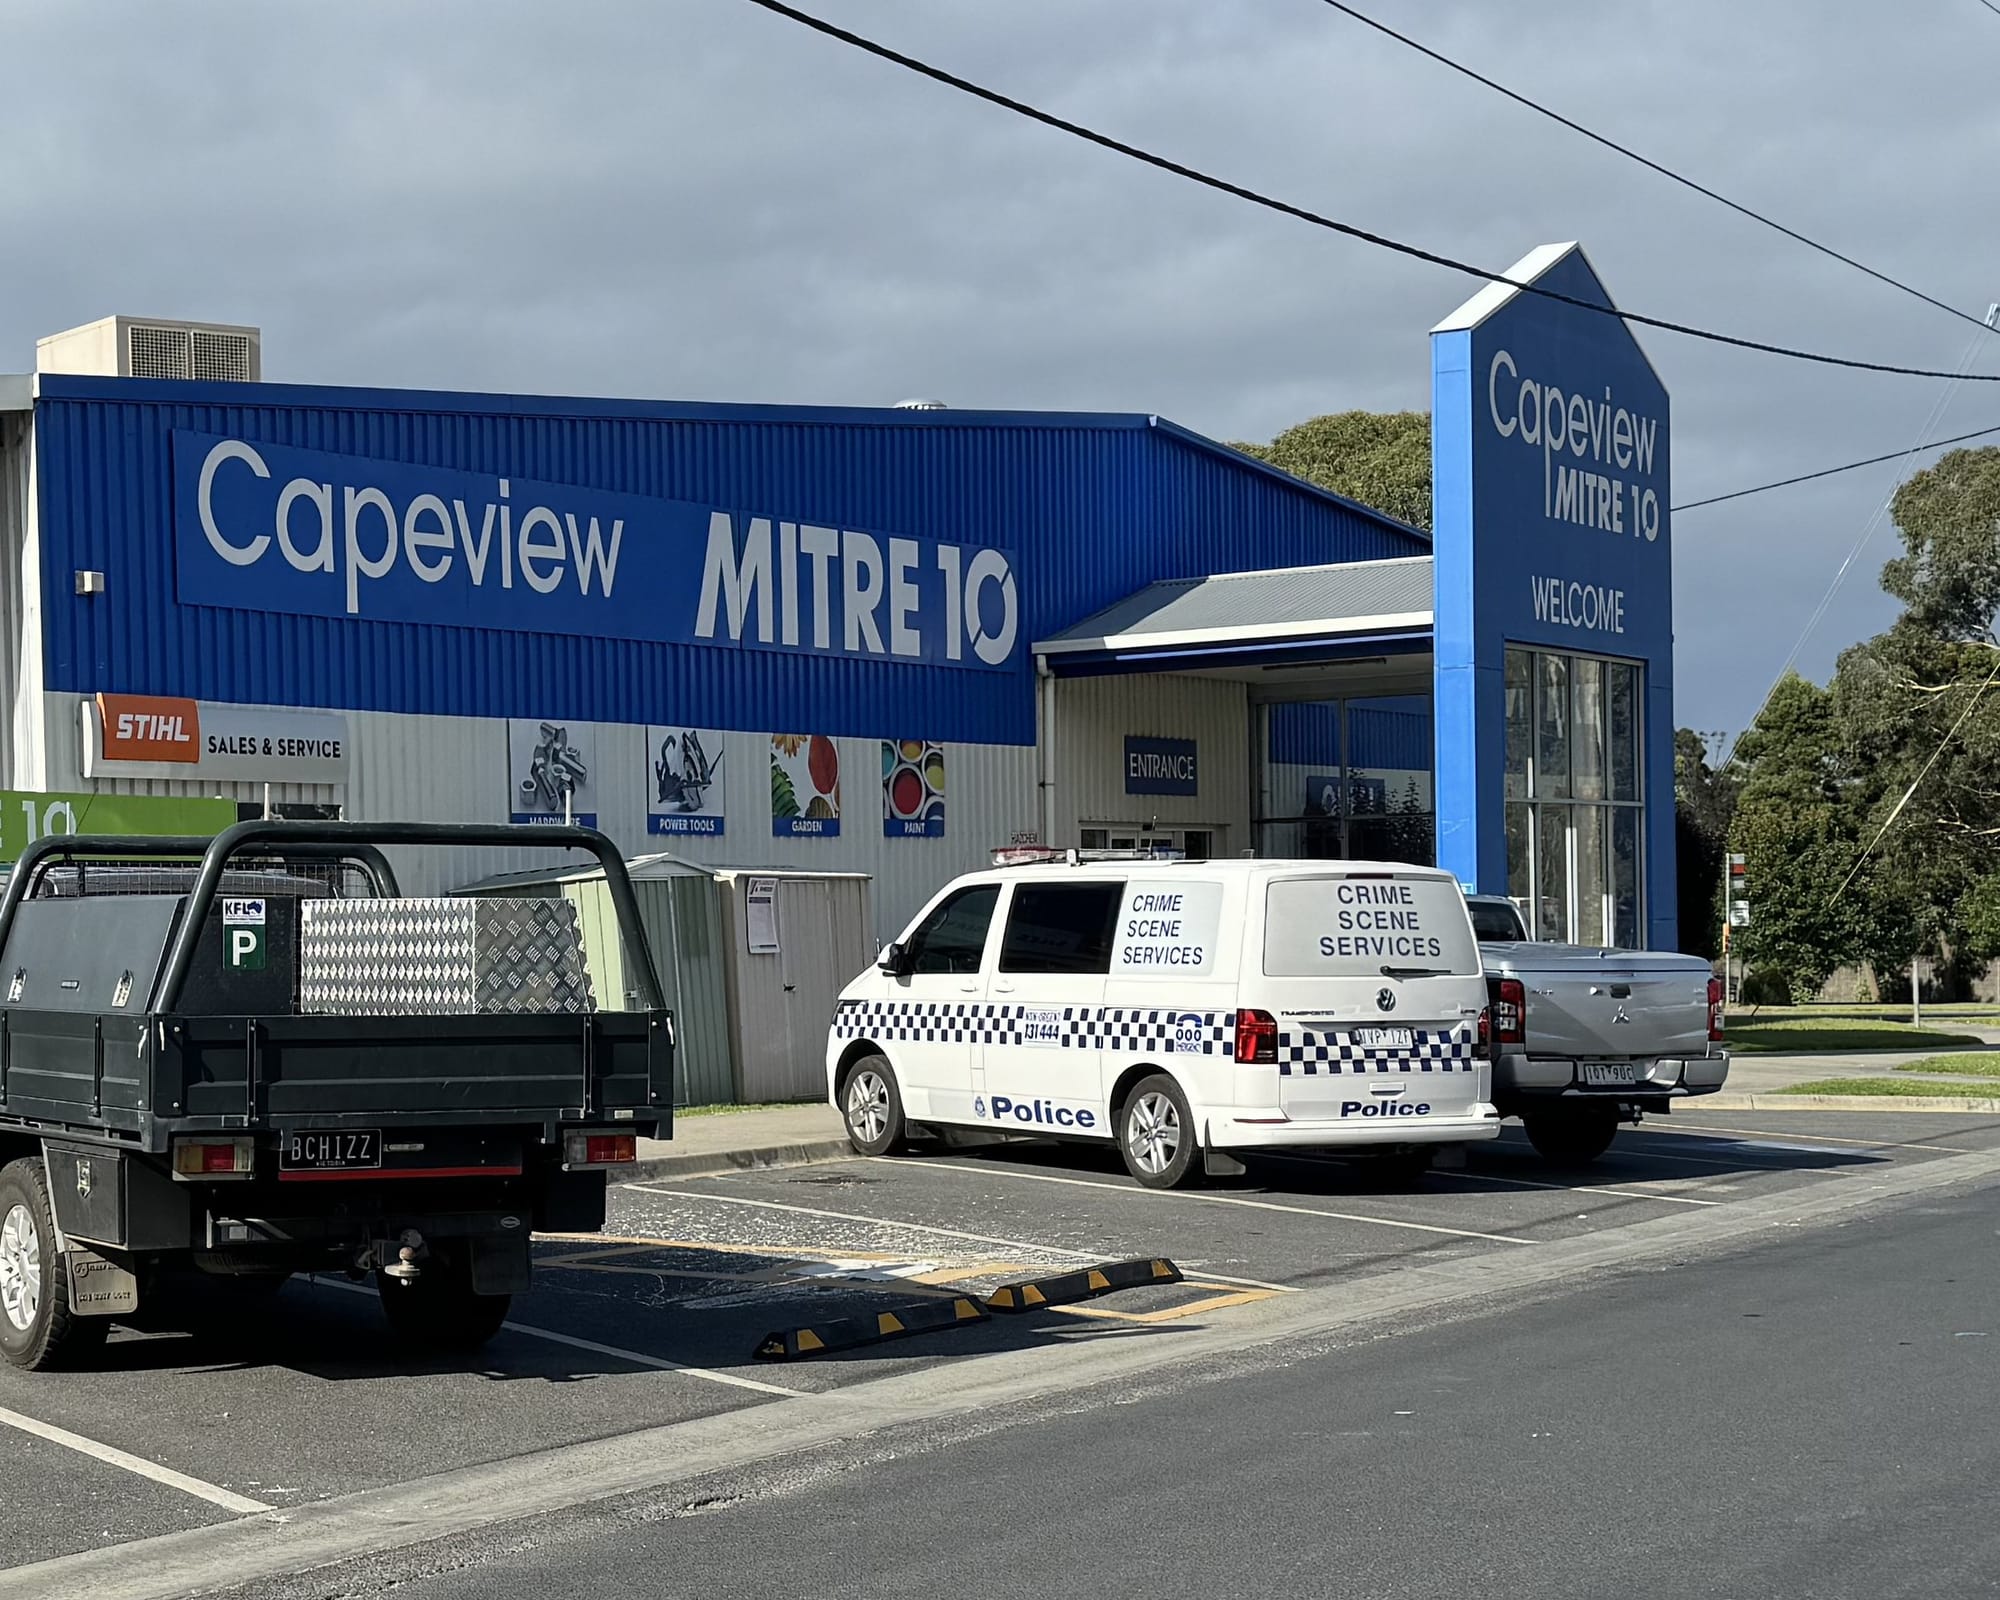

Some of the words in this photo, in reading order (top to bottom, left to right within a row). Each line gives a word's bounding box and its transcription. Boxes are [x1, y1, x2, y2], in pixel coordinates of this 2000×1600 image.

[1489, 350, 1657, 518] Capeview
[1554, 465, 1623, 534] MITRE
[1631, 485, 1659, 542] 10
[198, 440, 624, 613] Capeview
[694, 512, 921, 657] MITRE
[937, 544, 1017, 665] 10
[1532, 576, 1624, 634] WELCOME
[116, 714, 190, 742] STIHL
[208, 735, 257, 755] SALES
[262, 738, 273, 755] &
[278, 738, 341, 758] SERVICE
[1130, 753, 1194, 780] ENTRANCE
[659, 818, 688, 831] POWER
[690, 819, 715, 832] TOOLS
[792, 821, 822, 833] GARDEN
[904, 822, 926, 834] PAINT
[1132, 895, 1183, 912] CRIME
[1337, 885, 1413, 905] CRIME
[225, 902, 250, 915] KFL
[1127, 920, 1182, 938] SCENE
[1338, 911, 1420, 930] SCENE
[232, 930, 257, 966] P
[1123, 946, 1203, 965] SERVICES
[1320, 937, 1441, 957] SERVICES
[1175, 1028, 1202, 1042] 000
[991, 1096, 1096, 1128] Police
[1341, 1100, 1431, 1117] Police
